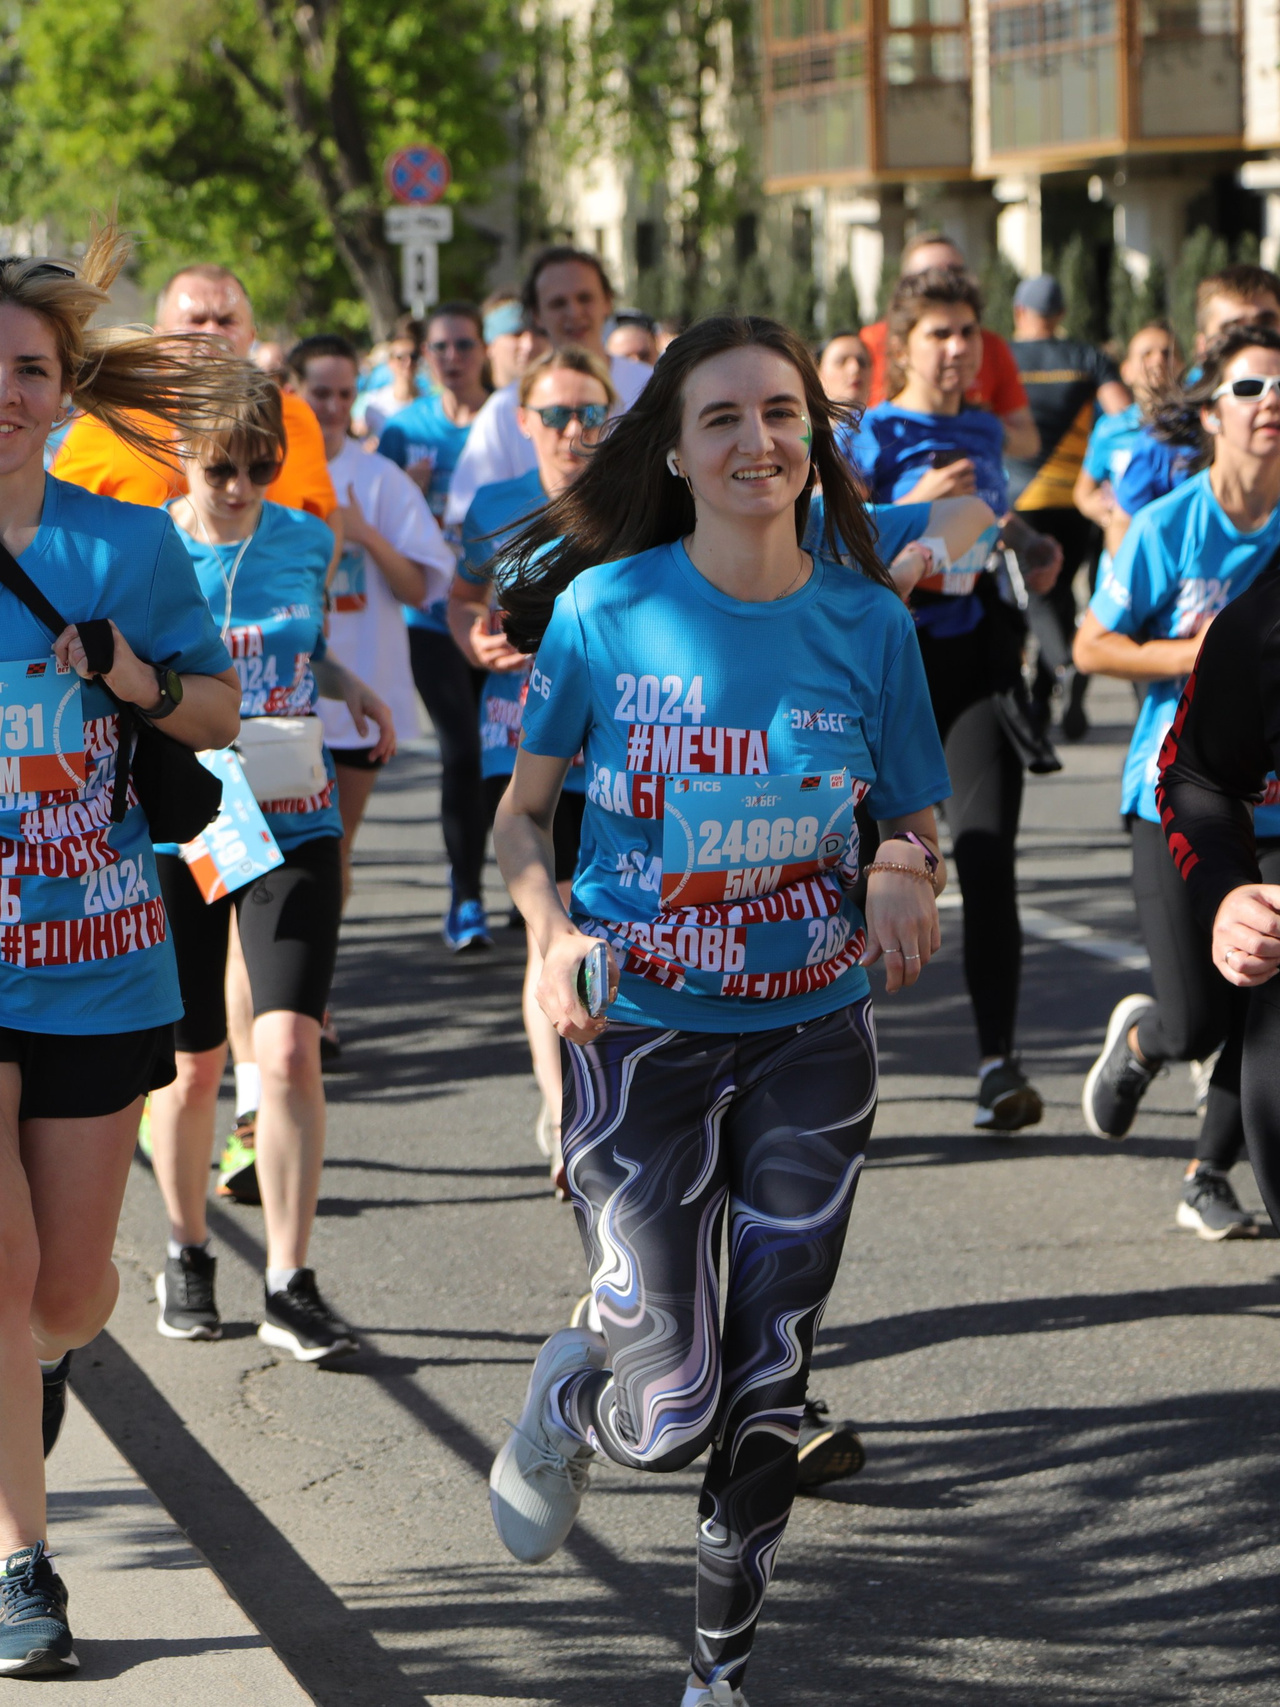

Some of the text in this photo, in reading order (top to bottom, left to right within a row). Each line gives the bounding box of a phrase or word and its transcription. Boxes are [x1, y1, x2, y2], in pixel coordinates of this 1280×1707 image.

[234, 655, 279, 690] 024
[530, 663, 552, 700] СБ
[614, 673, 706, 724] 2024
[626, 724, 770, 775] #МЕЧТА
[587, 760, 663, 820] #ЗАБ
[692, 781, 721, 792] ПСБ
[697, 816, 819, 866] 24868
[79, 854, 150, 916] 2024
